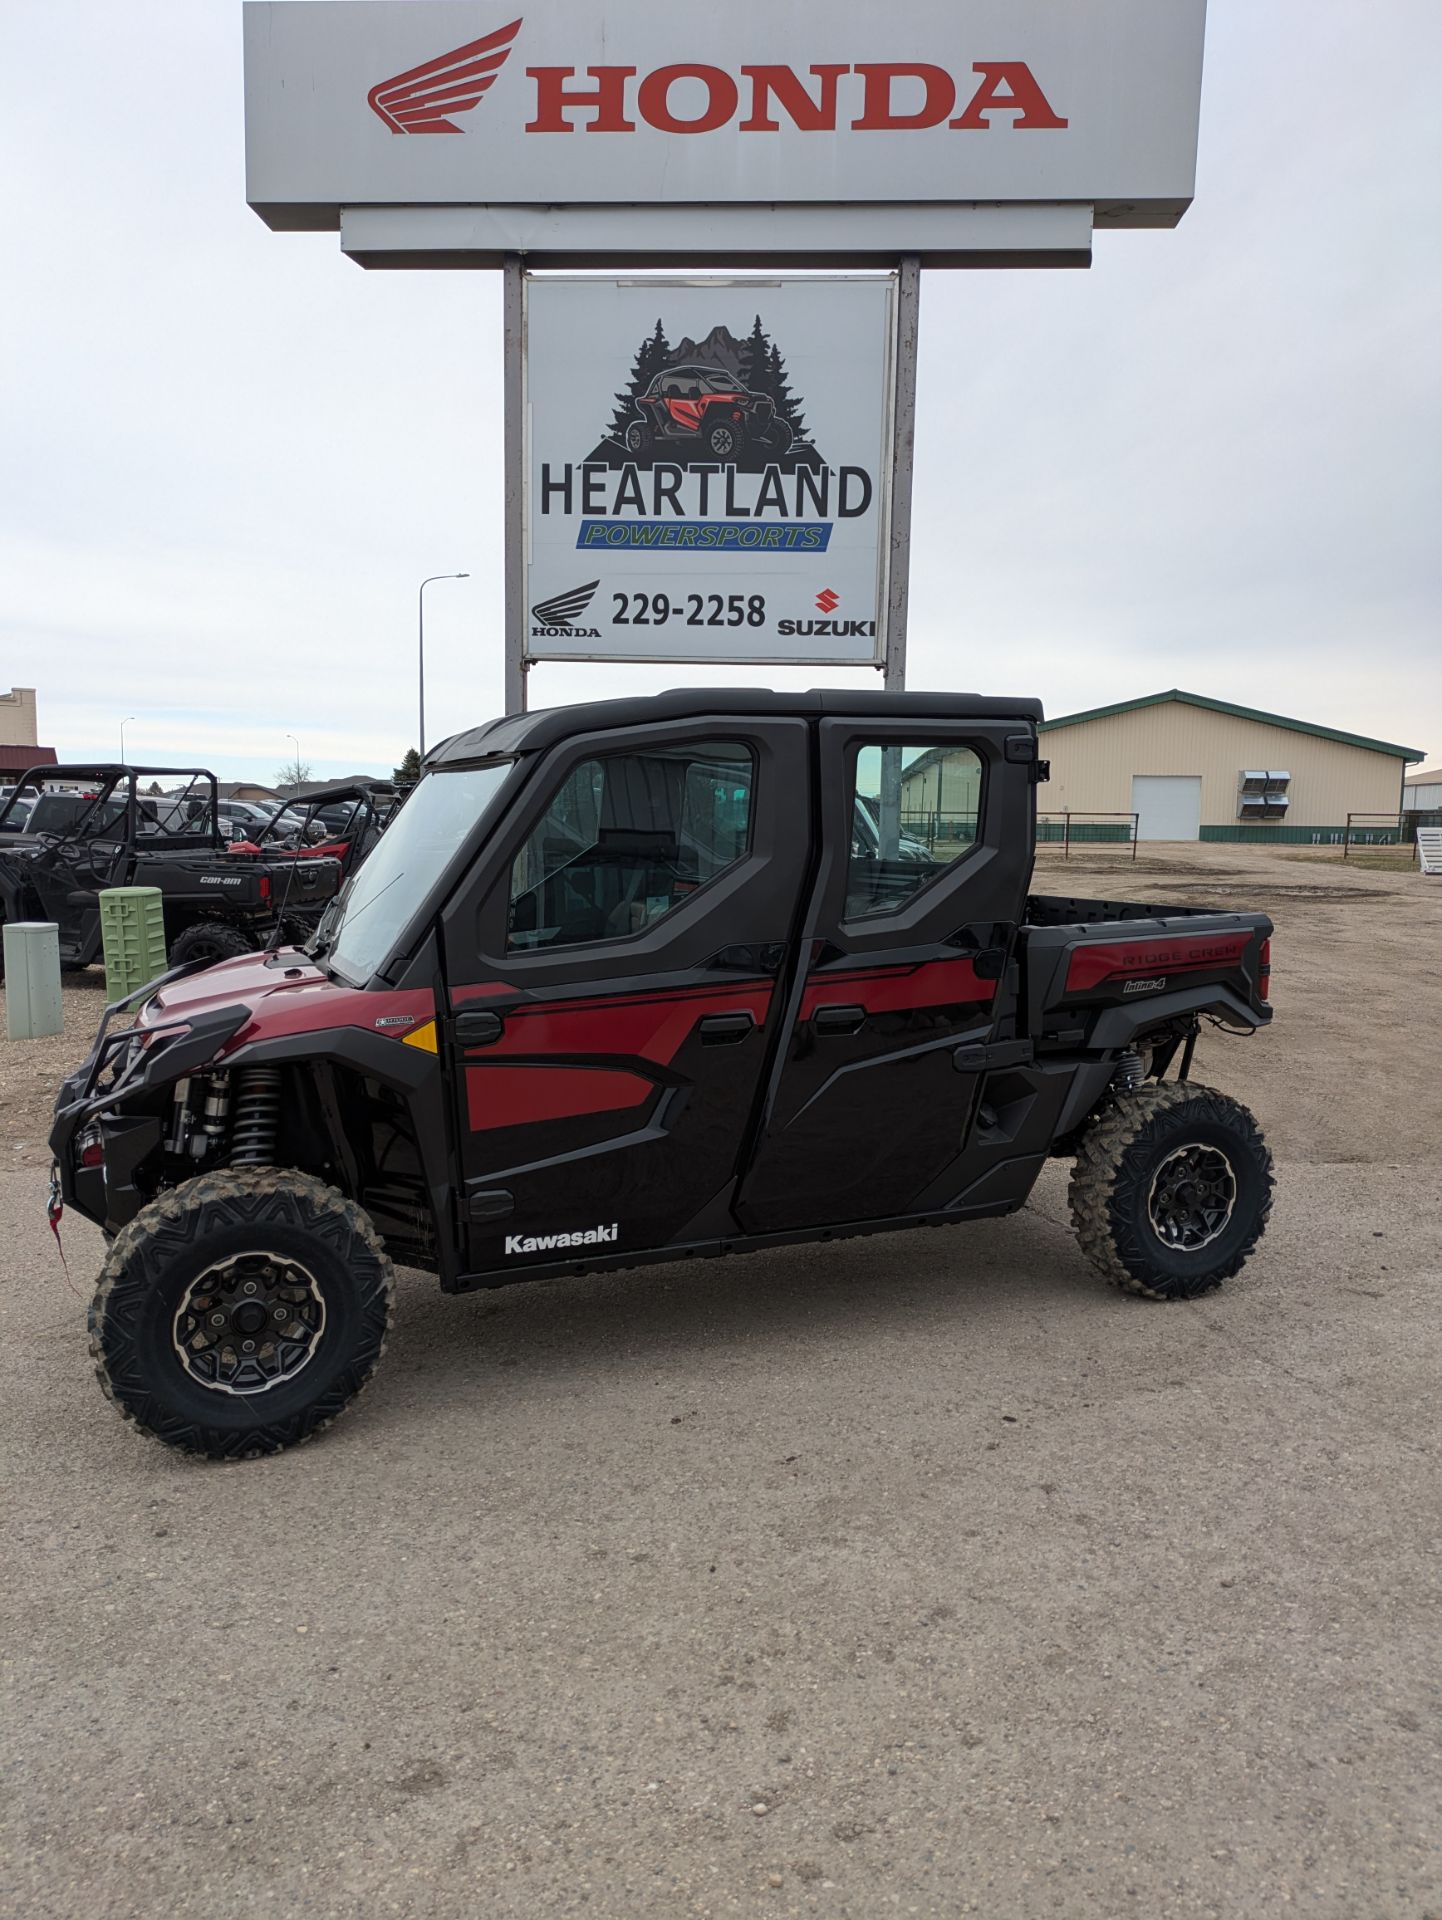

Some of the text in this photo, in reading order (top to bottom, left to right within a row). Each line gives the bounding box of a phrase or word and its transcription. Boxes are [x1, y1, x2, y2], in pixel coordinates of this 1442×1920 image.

[525, 61, 1069, 134] HONDA
[541, 462, 873, 518] HEARTLAND
[584, 524, 824, 548] POWERSPORTS
[612, 592, 766, 627] 229-2258
[531, 627, 602, 638] HONDA
[777, 619, 876, 637] SUZUKI
[199, 876, 242, 886] can-am
[1122, 944, 1237, 966] RIDGE CREW
[504, 1222, 619, 1255] Kawasaki
